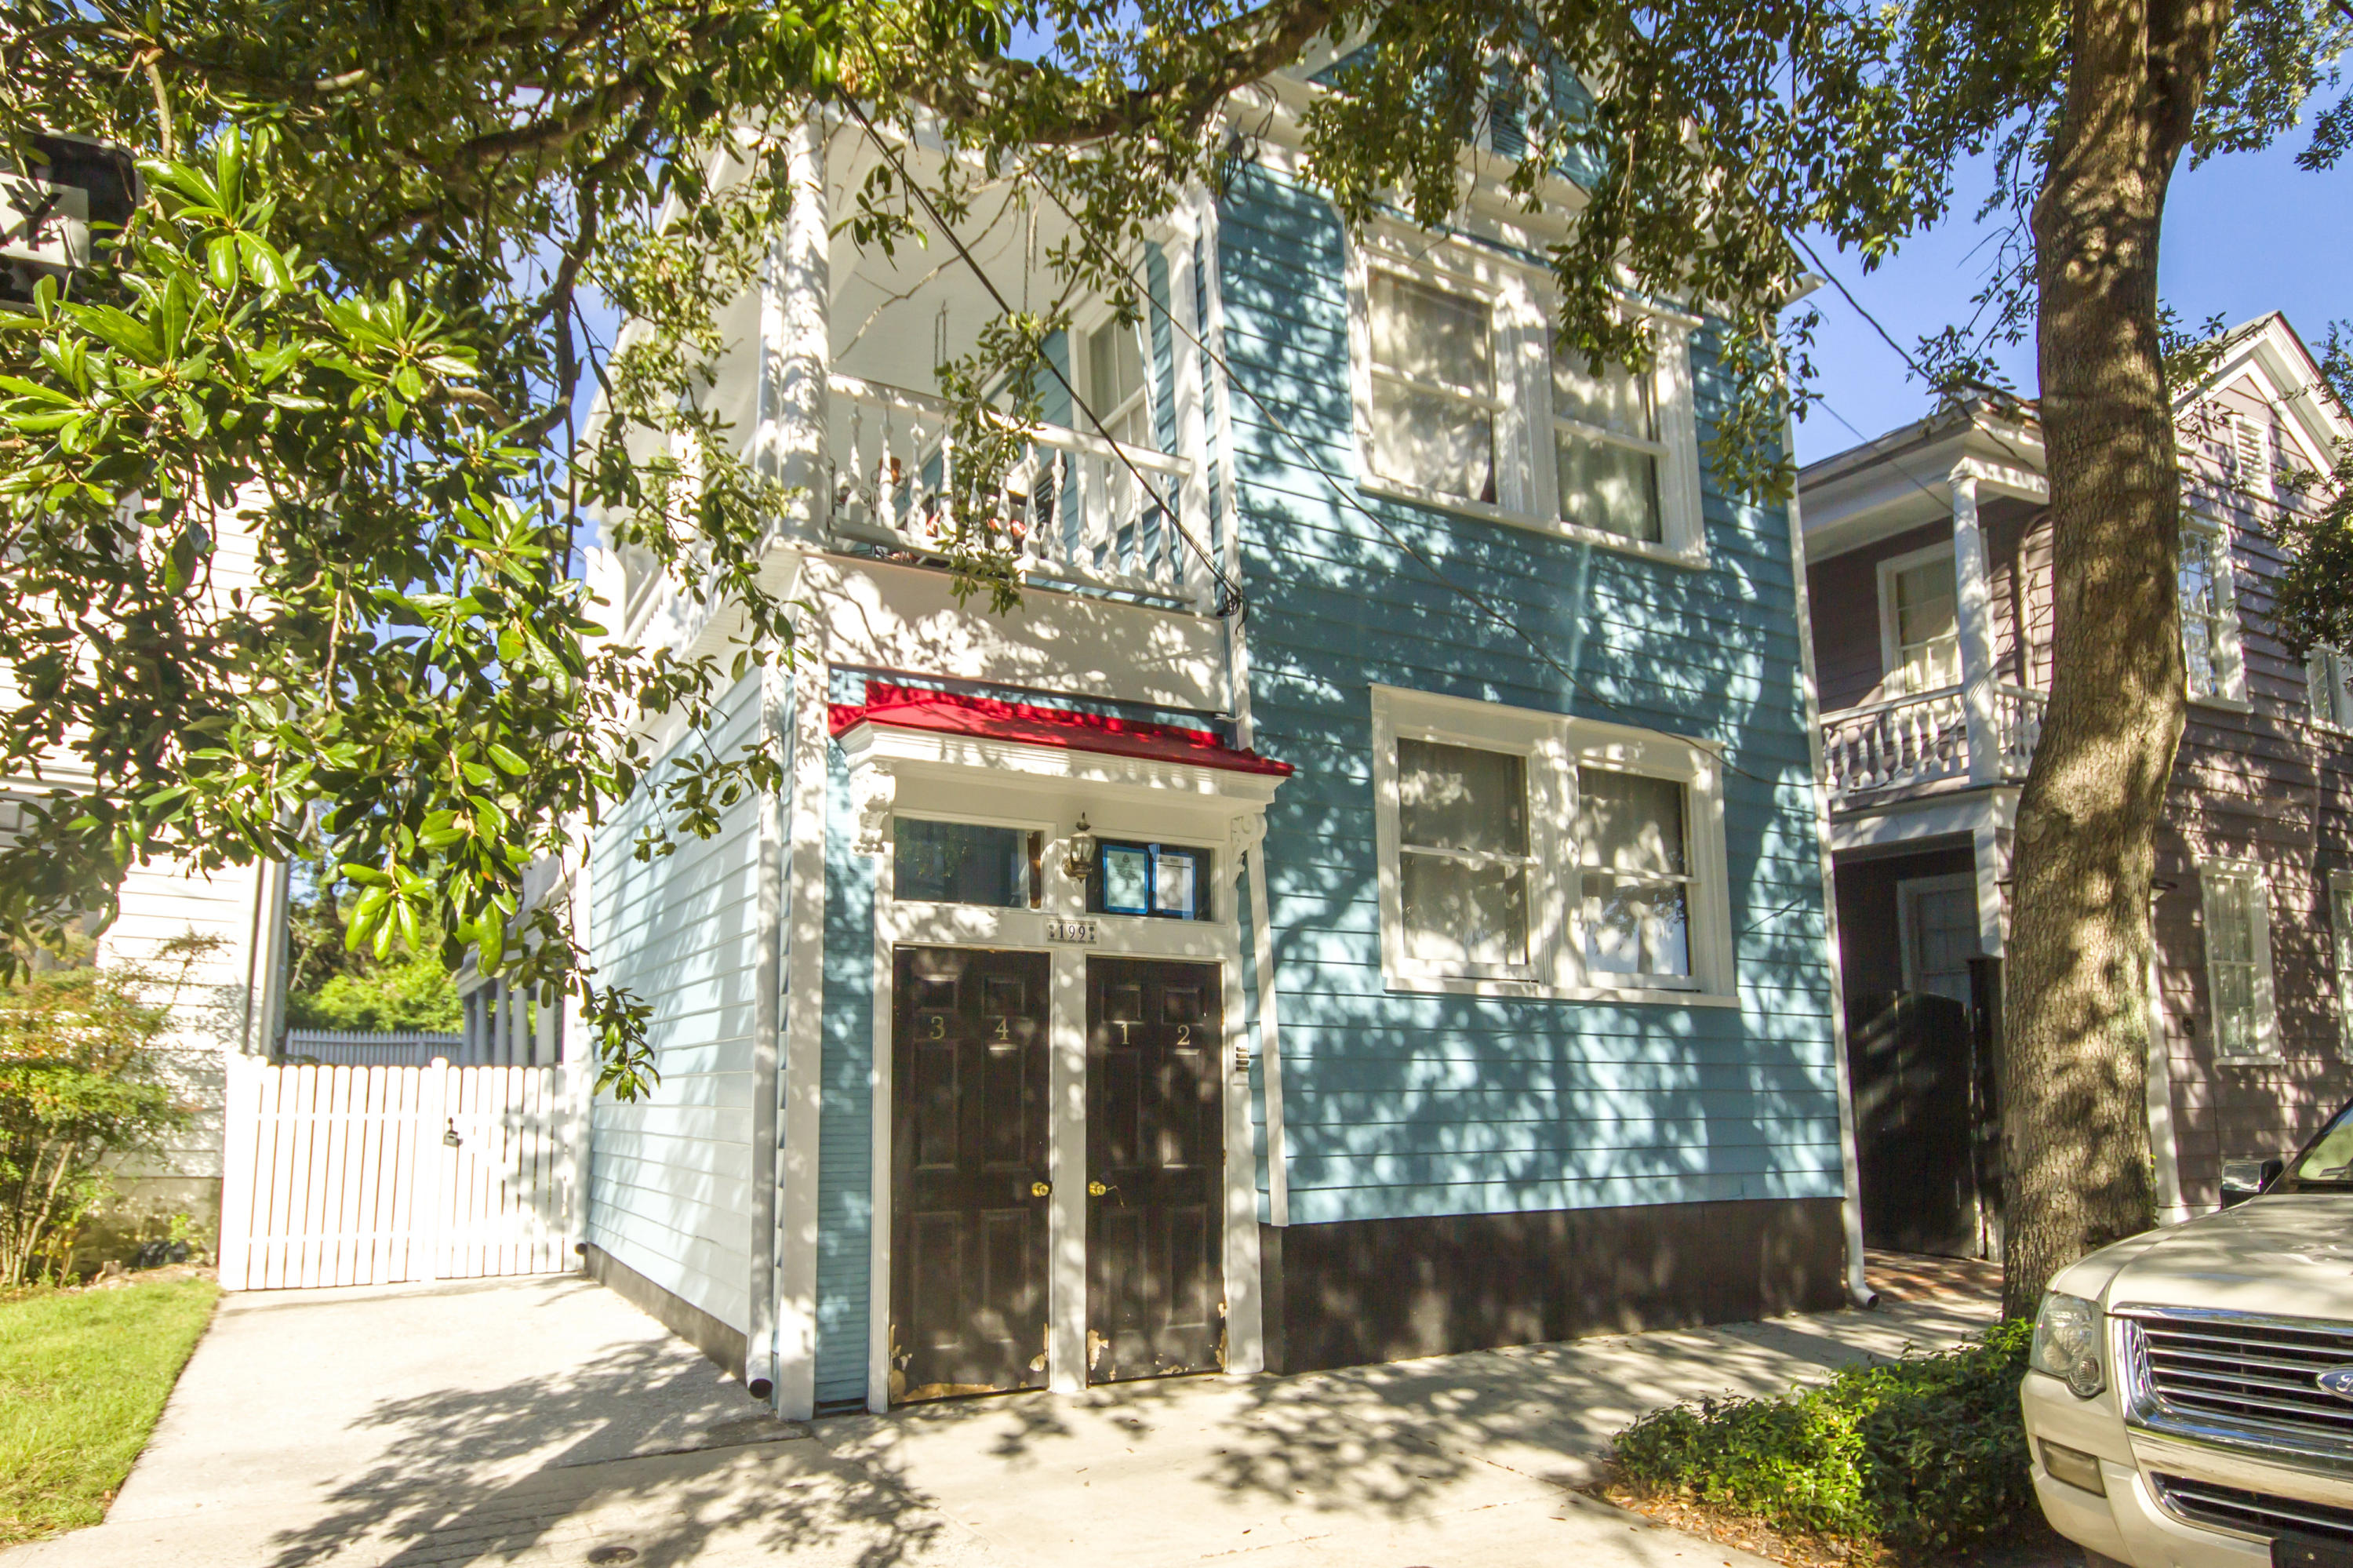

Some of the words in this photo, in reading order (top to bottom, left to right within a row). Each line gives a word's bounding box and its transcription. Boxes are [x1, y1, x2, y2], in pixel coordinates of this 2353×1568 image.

[1060, 924, 1086, 940] 199
[929, 1016, 946, 1039] 3
[995, 1017, 1009, 1040] 4
[1122, 1021, 1130, 1045] 1
[1176, 1024, 1191, 1046] 2
